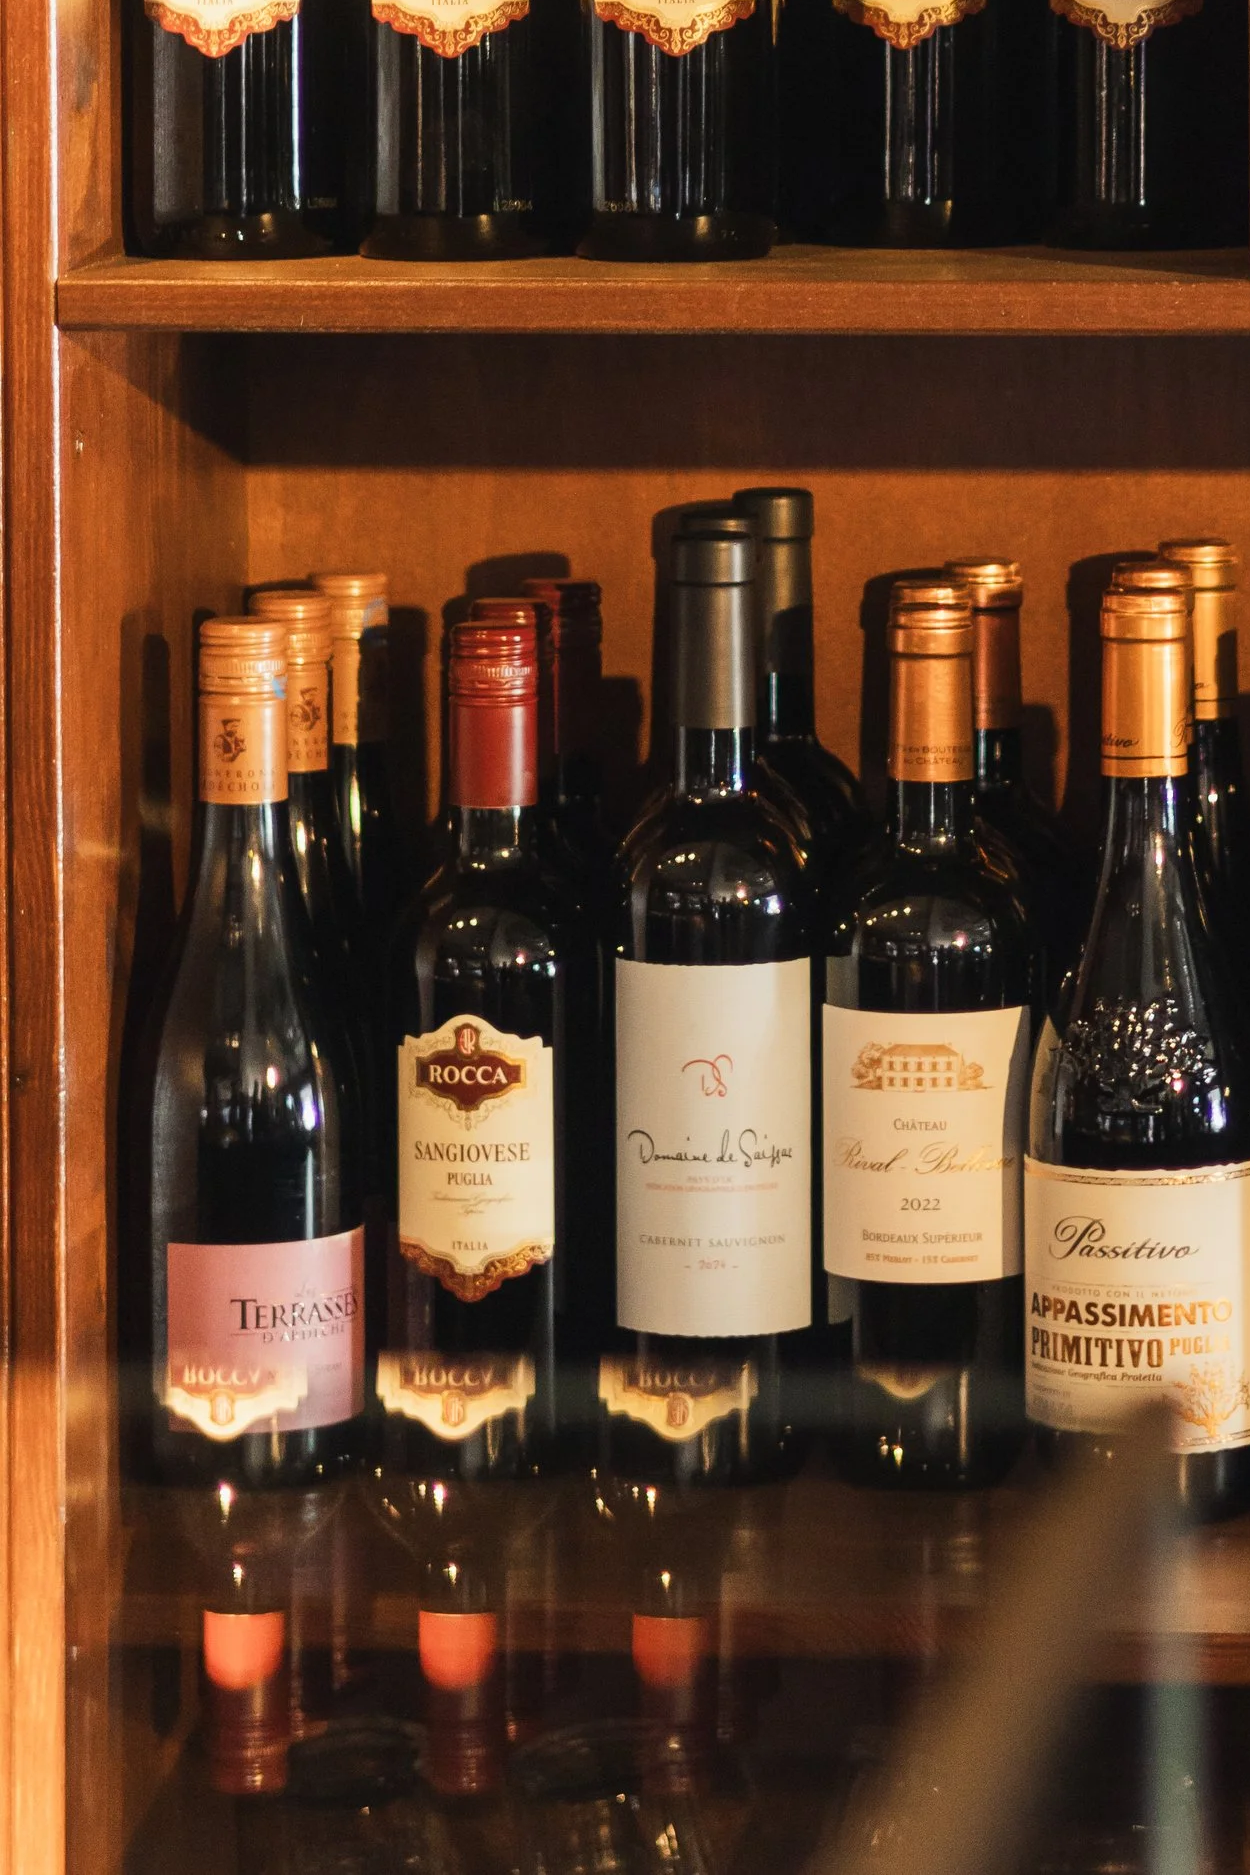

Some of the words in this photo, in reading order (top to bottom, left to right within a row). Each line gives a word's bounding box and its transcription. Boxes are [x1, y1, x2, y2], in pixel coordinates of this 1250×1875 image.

[429, 1065, 507, 1084] ROCCA
[893, 1118, 947, 1131] CHÂTEAU
[414, 1141, 530, 1163] SANGIOVESE
[628, 1129, 712, 1164] Domaine
[716, 1129, 737, 1163] de
[447, 1172, 492, 1186] PUGLIA
[900, 1198, 941, 1211] 2022
[709, 1235, 785, 1247] SAUVIGNON
[862, 1230, 918, 1243] BORDEAUX
[922, 1232, 983, 1244] SUPÉRIEUR
[1048, 1215, 1200, 1261] Passitivo
[451, 1241, 488, 1251] ITALIA
[1106, 1290, 1130, 1298] CON
[1031, 1293, 1232, 1328] APPASSIMENTO
[1031, 1326, 1163, 1368] PRIMITIVO
[1121, 1372, 1162, 1382] Protetta
